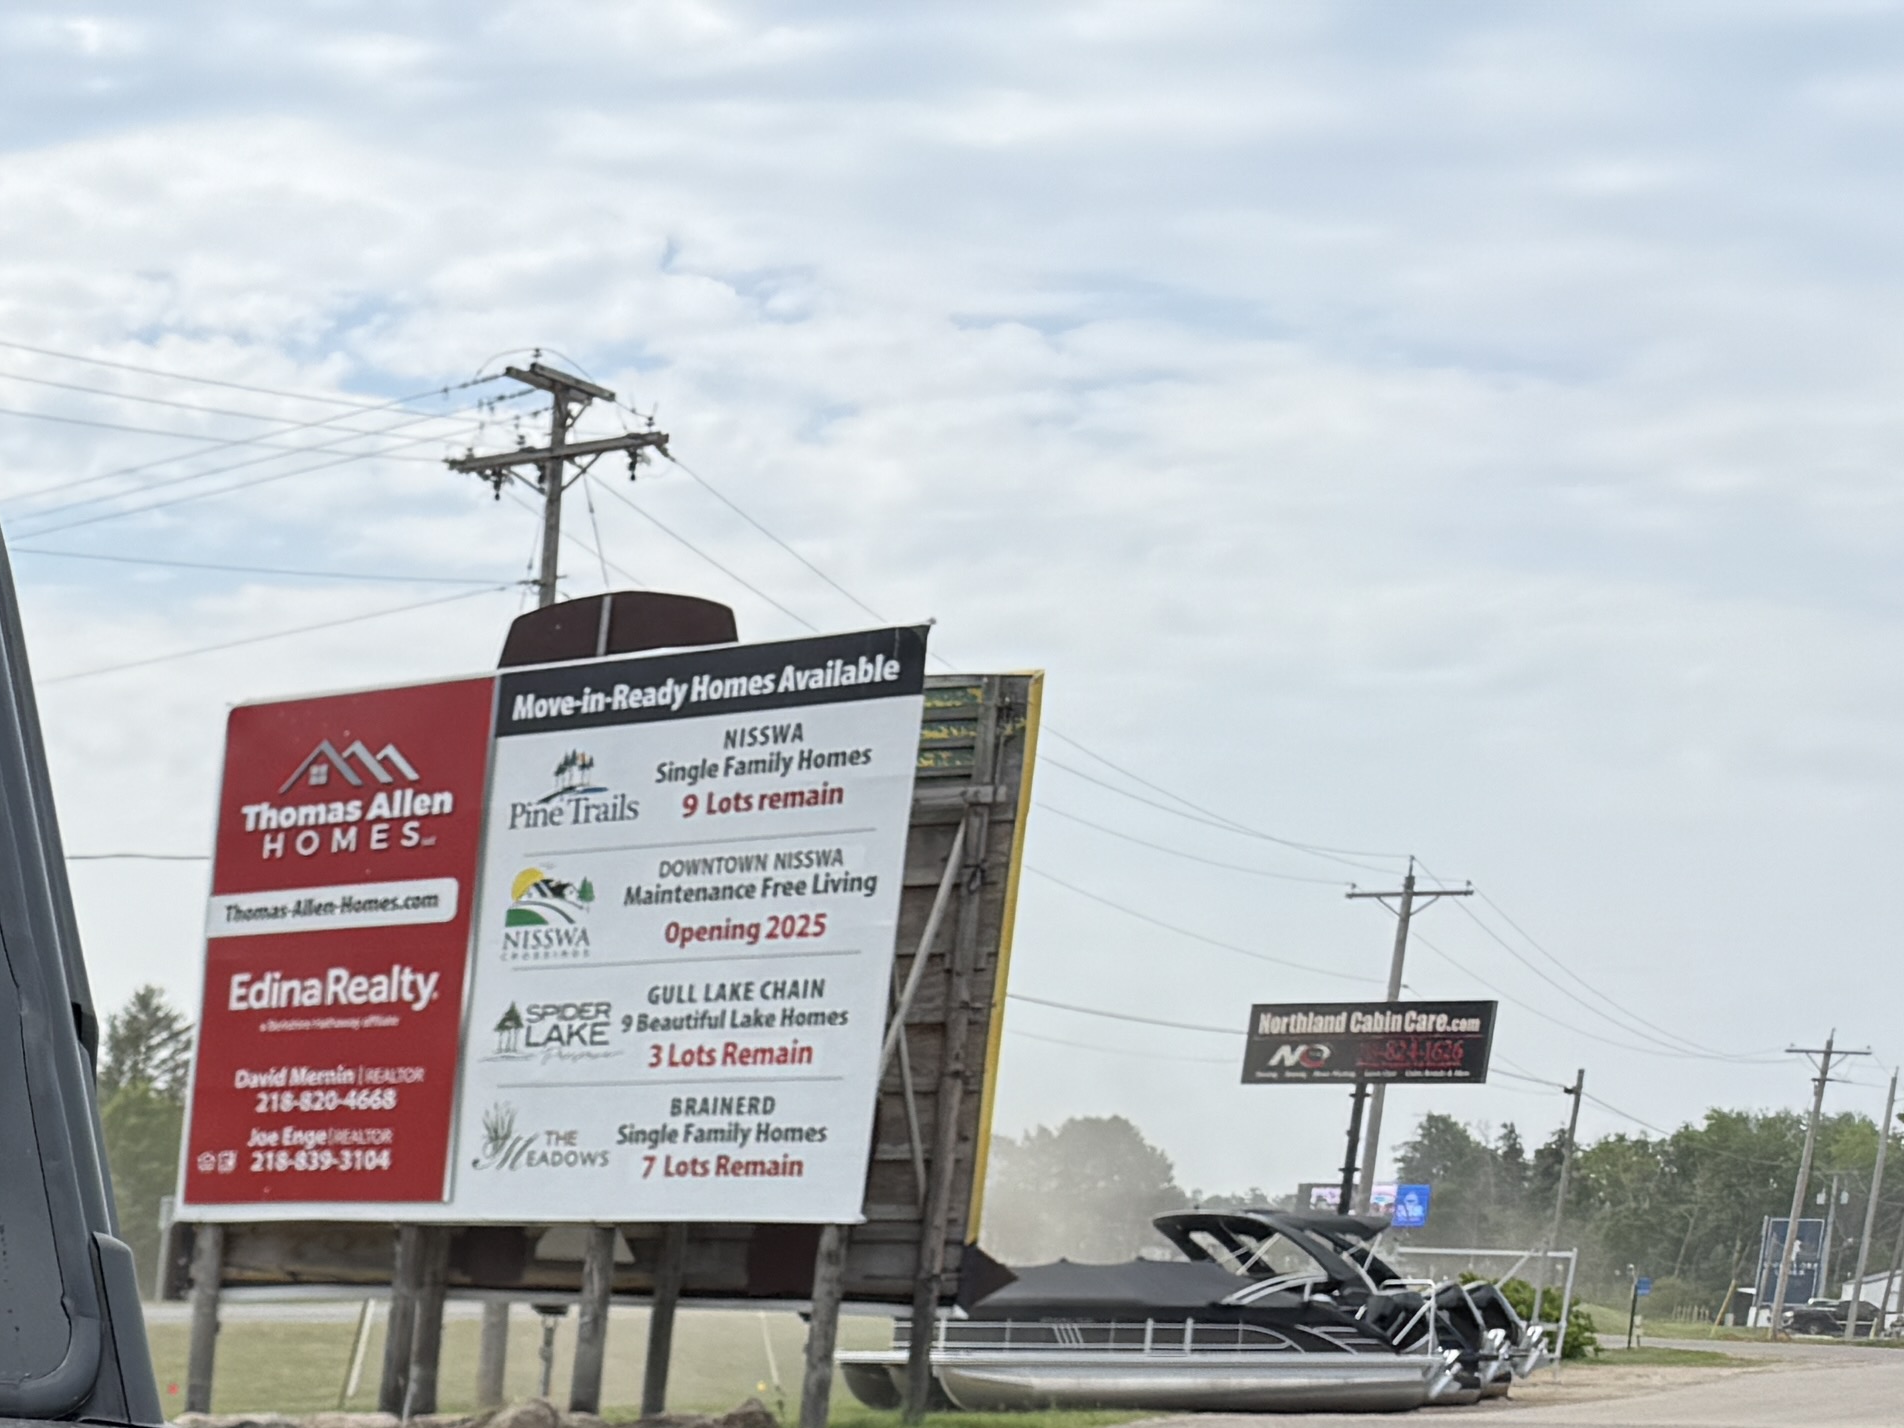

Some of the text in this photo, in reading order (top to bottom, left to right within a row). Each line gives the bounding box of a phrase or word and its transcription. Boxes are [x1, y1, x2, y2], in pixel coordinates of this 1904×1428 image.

[512, 654, 901, 721] Move-in-Ready Homes Available
[723, 722, 804, 750] NISSWA
[655, 746, 872, 785] Single Family Homes
[241, 788, 454, 832] Thomas Allen
[509, 793, 640, 831] Pine Trails
[681, 782, 844, 818] 9 Lots remain
[262, 820, 421, 859] HOMES
[659, 848, 844, 879] DOWNTOWN NISSWA
[623, 873, 878, 906] Maintenance Free Living
[502, 926, 590, 950] NISSWA
[665, 913, 828, 949] Opening 2025
[648, 978, 826, 1006] GULL LAKE CHAIN
[526, 1001, 612, 1024] SPIDER
[621, 1006, 849, 1033] 9 Beautiful Lake Homes
[1258, 1011, 1348, 1034] Northland
[525, 1021, 611, 1047] LAKE
[648, 1043, 662, 1068] 3
[667, 1042, 716, 1067] Lots
[721, 1038, 813, 1066] Remain
[234, 1066, 288, 1089] David
[670, 1096, 776, 1117] BRAINERD
[247, 1127, 279, 1147] Joe
[544, 1129, 578, 1147] THE
[616, 1122, 827, 1149] Single Family Homes
[642, 1154, 804, 1179] 7 Lots Remain
